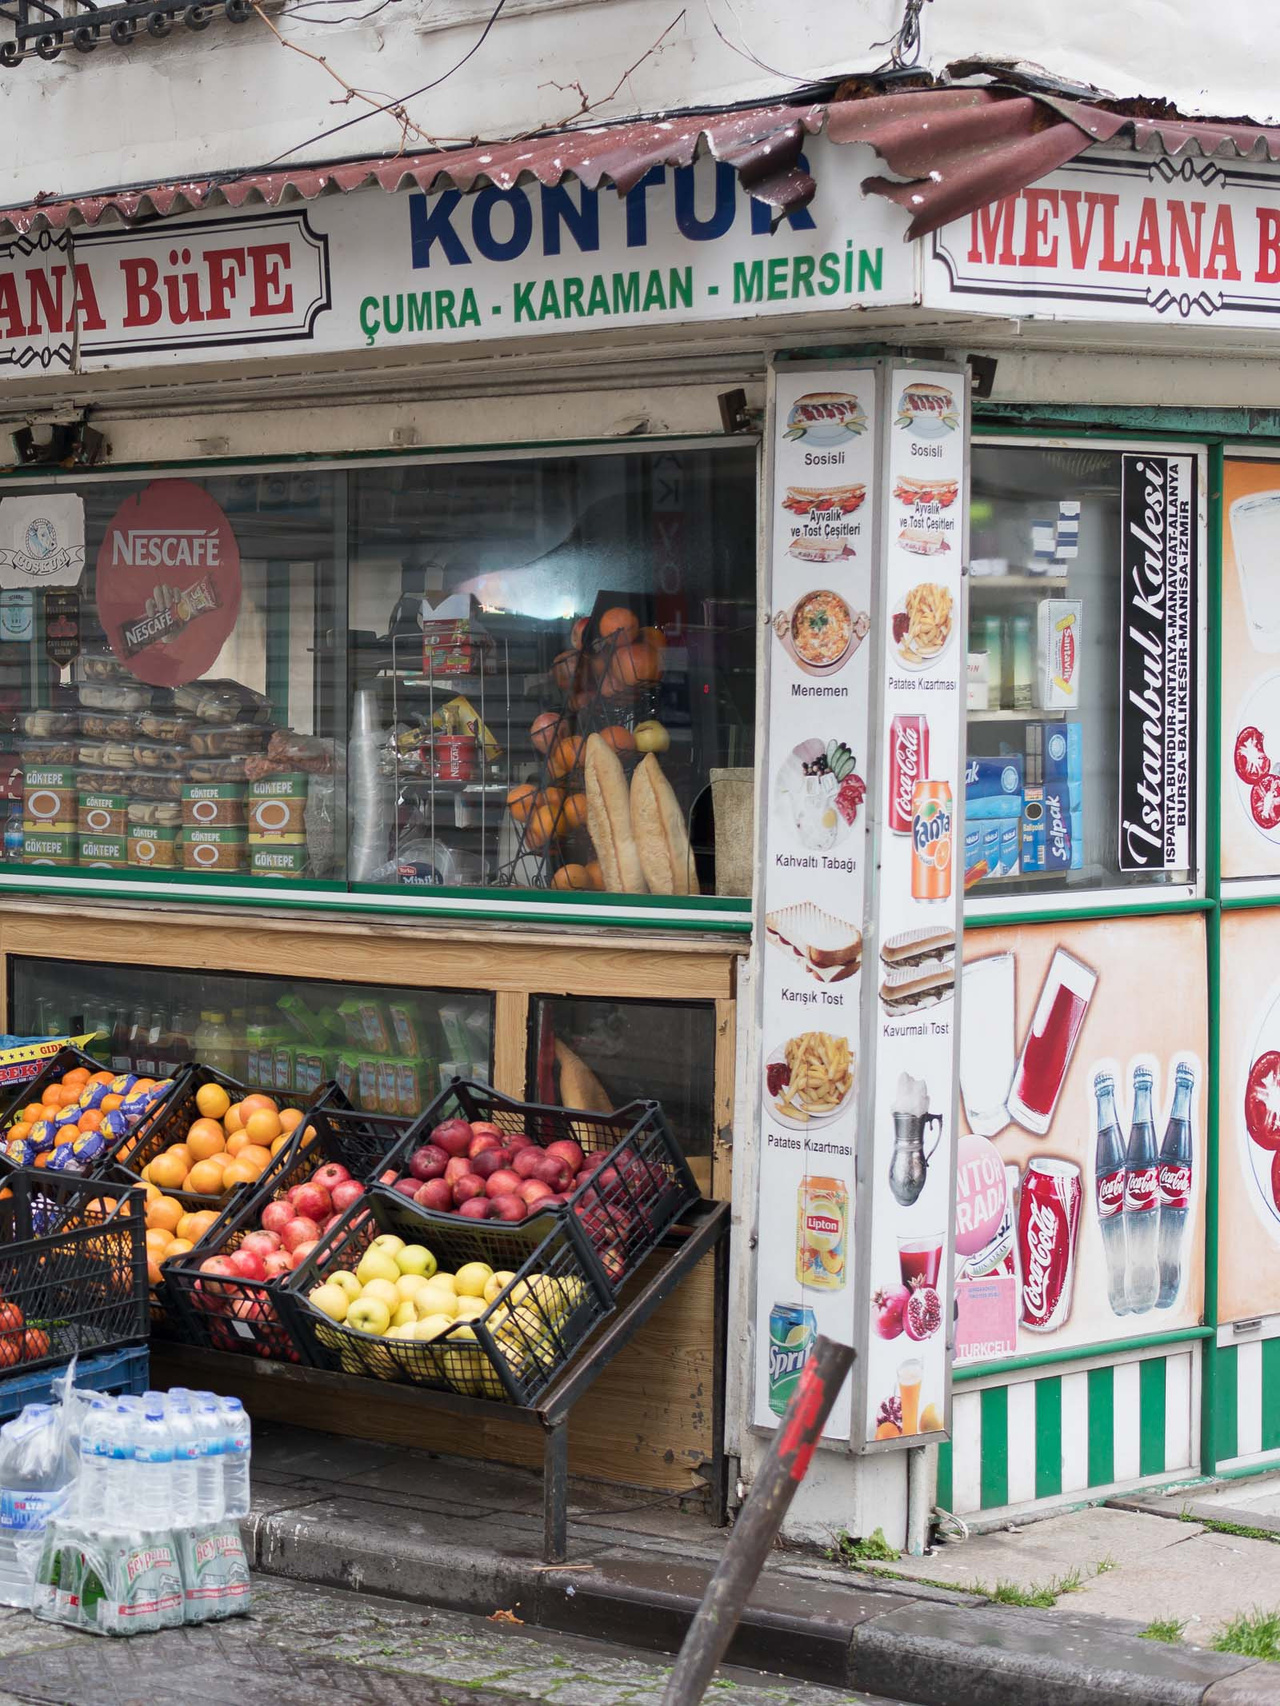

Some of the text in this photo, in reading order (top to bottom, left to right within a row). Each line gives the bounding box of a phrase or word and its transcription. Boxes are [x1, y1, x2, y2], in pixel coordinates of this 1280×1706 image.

[967, 188, 1241, 282] MEVLANA
[358, 286, 481, 346] ÇUMRA
[513, 265, 693, 323] KARAMAN
[733, 239, 884, 304] MERSİN
[804, 451, 845, 465] Sosisli
[911, 443, 942, 458] Sosisli
[810, 509, 841, 525] Ayvalık
[915, 502, 940, 517] Ayvalık
[791, 523, 861, 539] ve Tost Çeşitleri
[899, 516, 955, 533] ve Tost Çeşitleri
[112, 528, 219, 567] NESCAFÉ
[1123, 460, 1165, 865] İstanbul Kalesi
[791, 684, 848, 697] Menemen
[889, 677, 957, 690] Patates Kızartması
[26, 772, 63, 786] GÖKTEPE
[190, 787, 219, 799] GÖKTEPE
[254, 781, 293, 794] GÖKTEPE
[86, 796, 113, 808] GÖKTEPE
[132, 827, 158, 839] GÖKTEPE
[1045, 795, 1067, 861] Selpak
[191, 831, 220, 843] GÖKTEPE
[25, 841, 62, 854] GÖKTEPE
[82, 843, 119, 858] GÖKTEPE
[255, 854, 294, 868] GÖKTEPE
[775, 854, 856, 873] Kahvaltı Tabağı
[781, 988, 843, 1006] Karışık Tost
[883, 1022, 949, 1037] Kavurmalı Tost
[767, 1134, 853, 1156] Patates Kızartması
[957, 1154, 1003, 1202] NTÖR
[808, 1218, 837, 1230] Lipton
[959, 1340, 1013, 1360] TURKCELL
